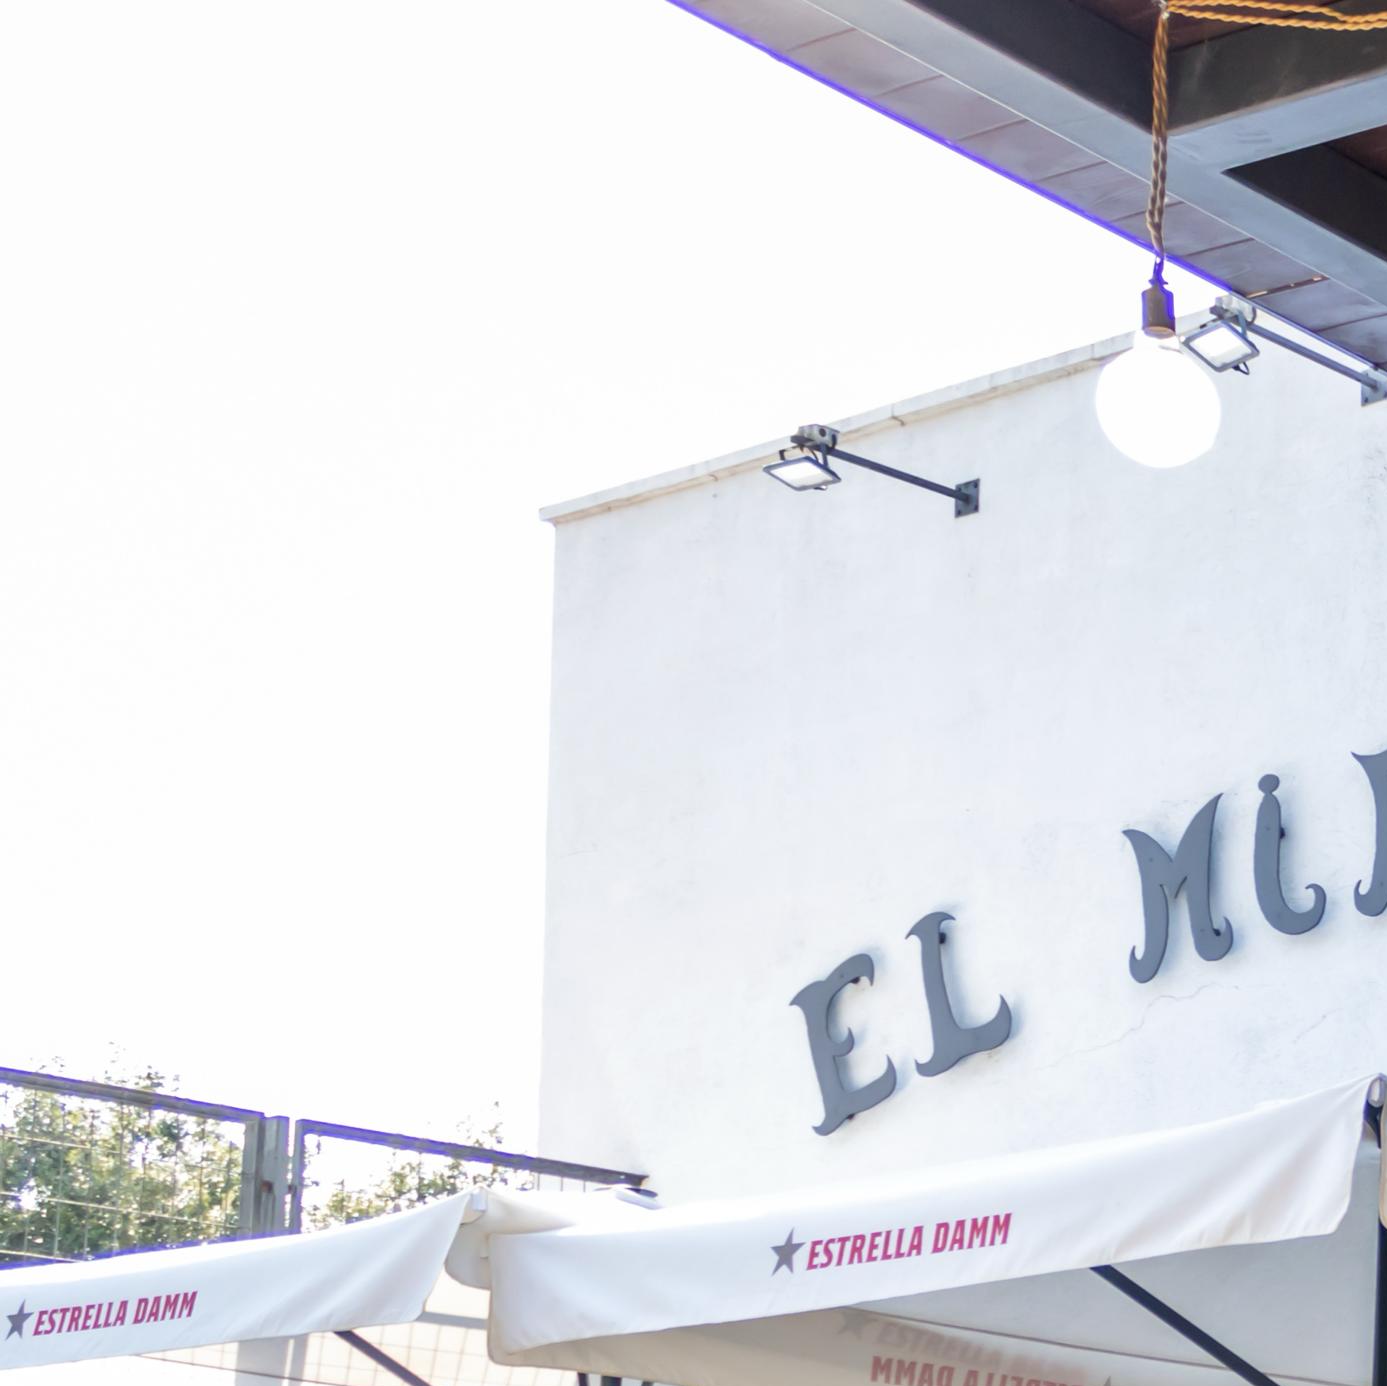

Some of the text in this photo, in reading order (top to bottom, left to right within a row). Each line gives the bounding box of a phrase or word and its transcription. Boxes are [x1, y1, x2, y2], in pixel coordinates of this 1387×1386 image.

[788, 911, 1012, 1137] EL
[805, 1212, 1013, 1271] ESTRELLA DAMM
[32, 1291, 198, 1336] ESTRELLA DAMM
